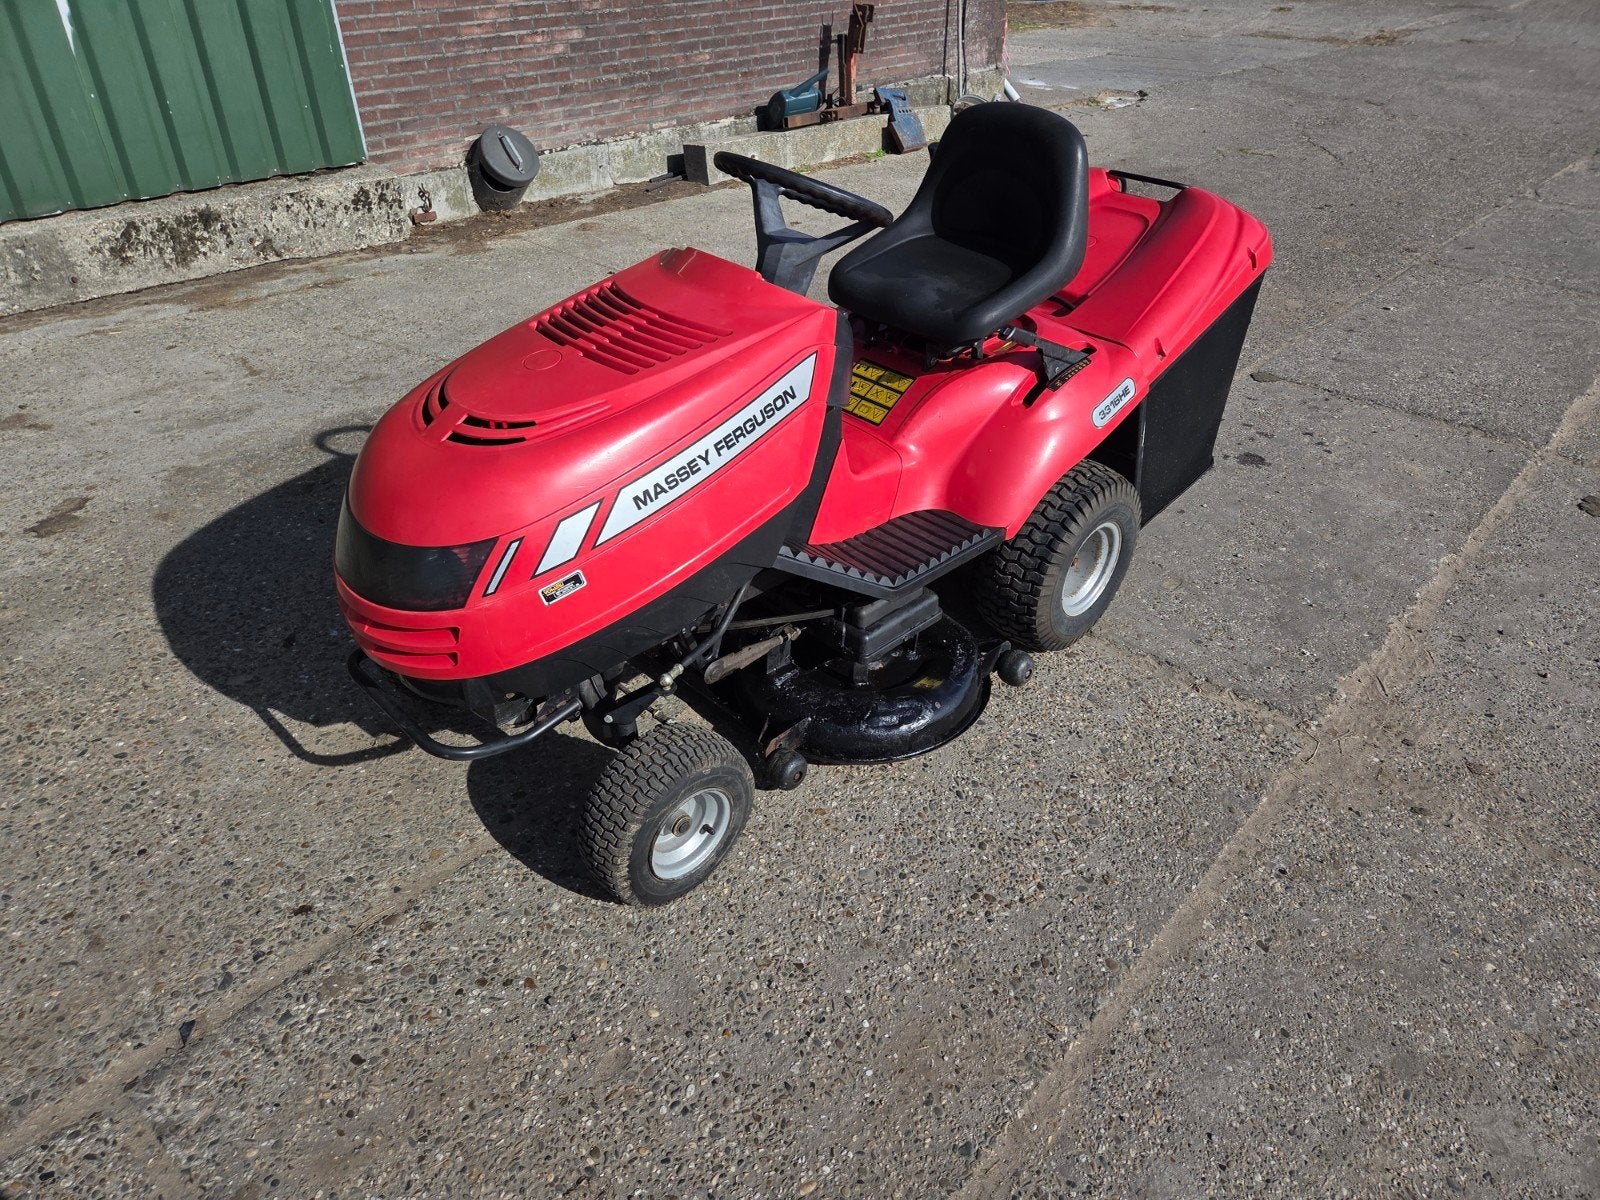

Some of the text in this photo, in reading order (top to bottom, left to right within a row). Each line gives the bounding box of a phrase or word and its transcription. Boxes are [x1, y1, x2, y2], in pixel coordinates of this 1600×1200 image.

[1098, 385, 1131, 420] 3316HE
[632, 385, 798, 511] MASSEY FERGUSON
